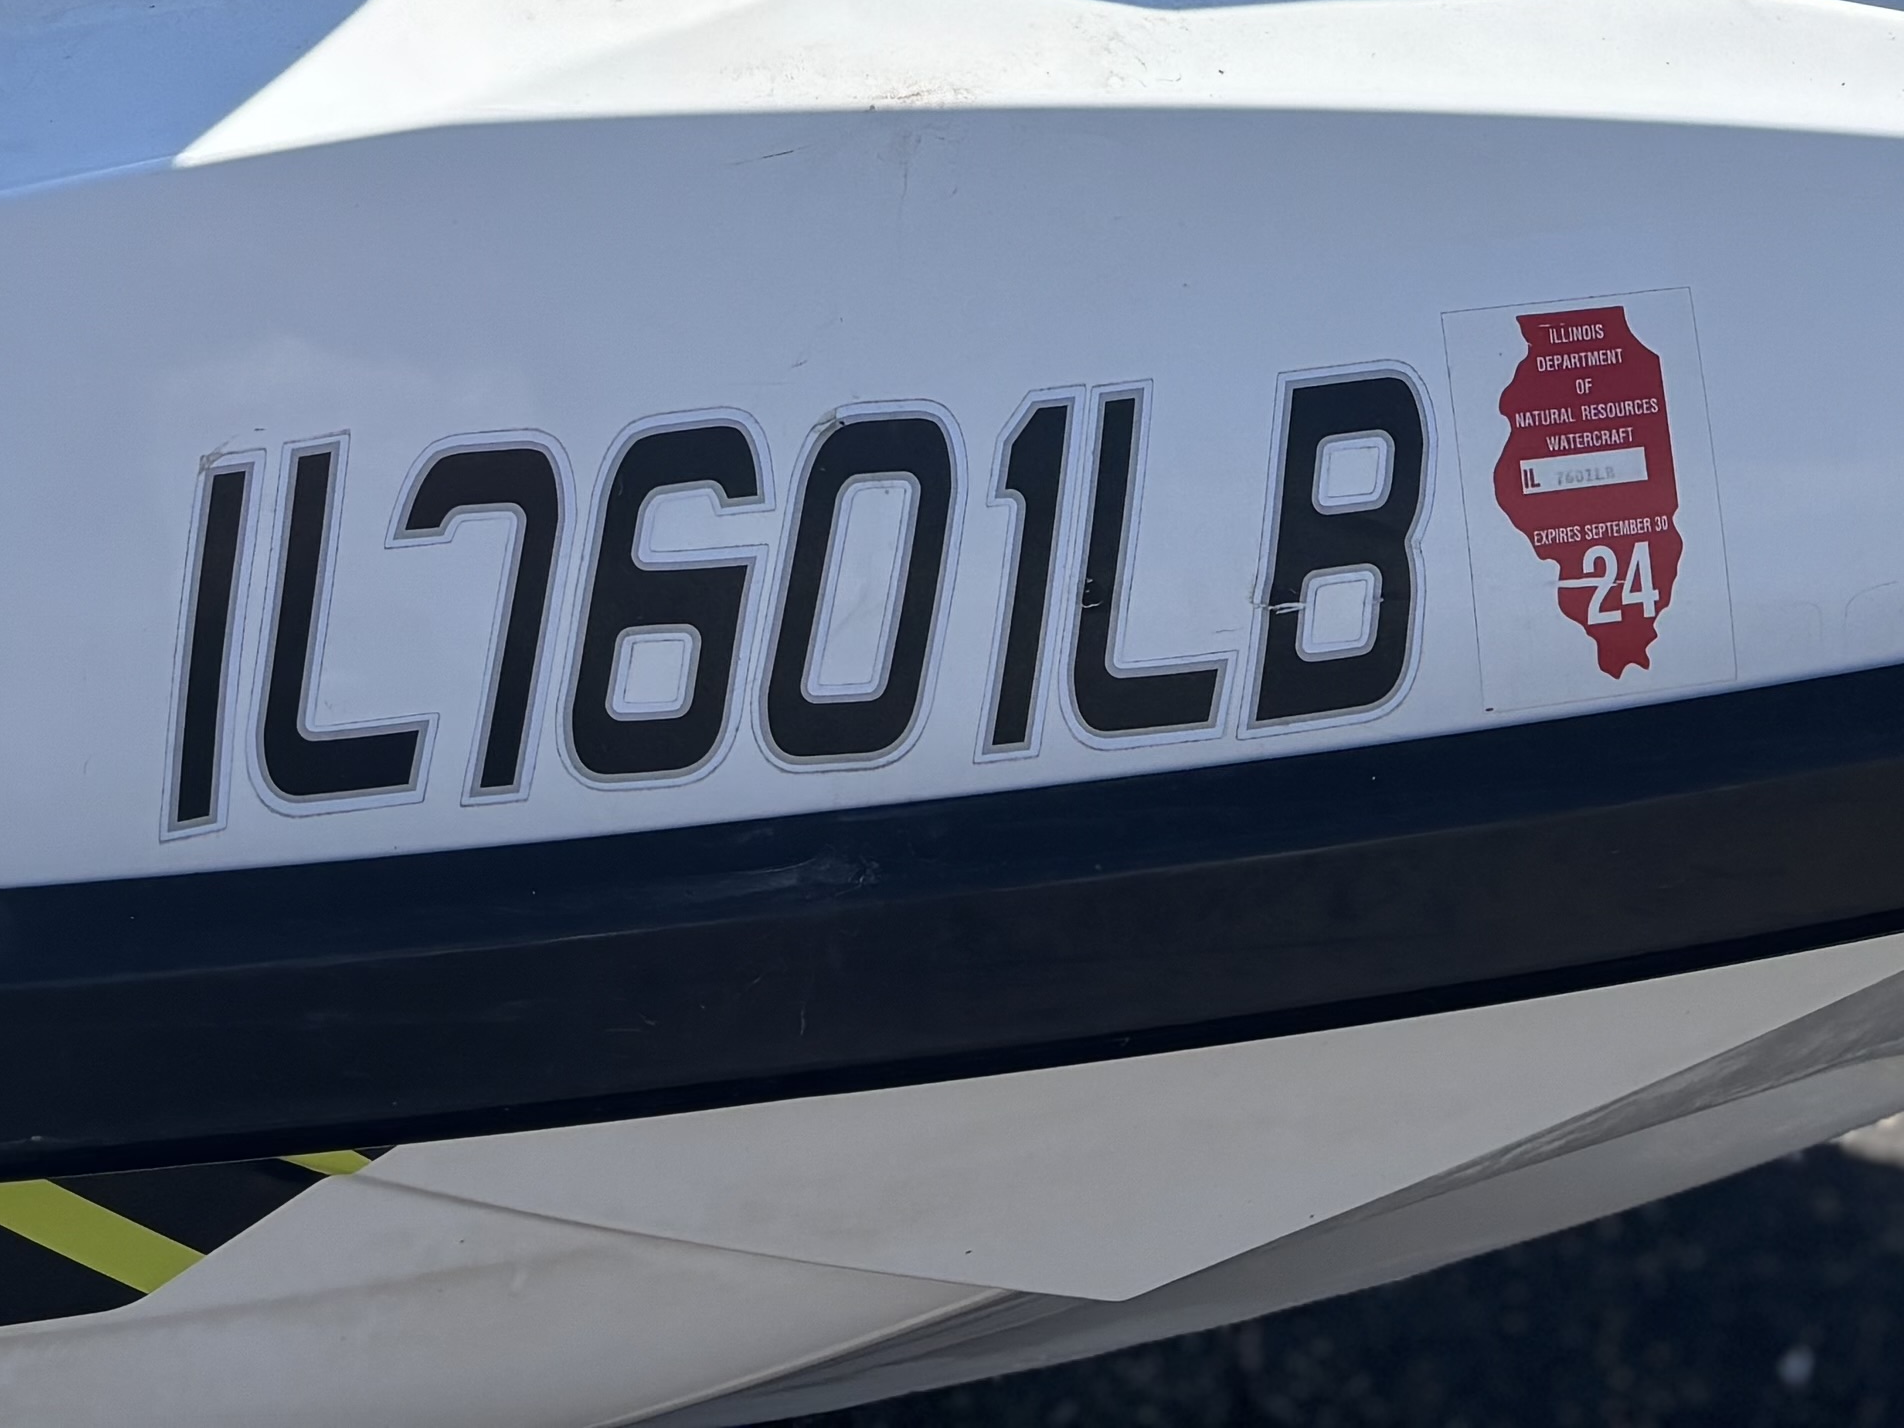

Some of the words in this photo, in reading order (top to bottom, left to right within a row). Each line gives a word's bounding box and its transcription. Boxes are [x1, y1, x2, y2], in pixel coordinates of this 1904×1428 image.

[1549, 324, 1604, 344] ILLINOIS
[1537, 349, 1623, 372] DEPARTMENT
[1575, 378, 1593, 394] OF
[1515, 407, 1576, 428] NATURAL
[1582, 398, 1659, 421] RESOURCES
[1546, 427, 1634, 452] WATERCRAFT
[1523, 468, 1541, 489] IL
[1534, 525, 1582, 546] EXPIRES
[1584, 518, 1652, 542] SEPTEMBER
[1655, 515, 1669, 532] 30
[1582, 541, 1660, 625] 24
